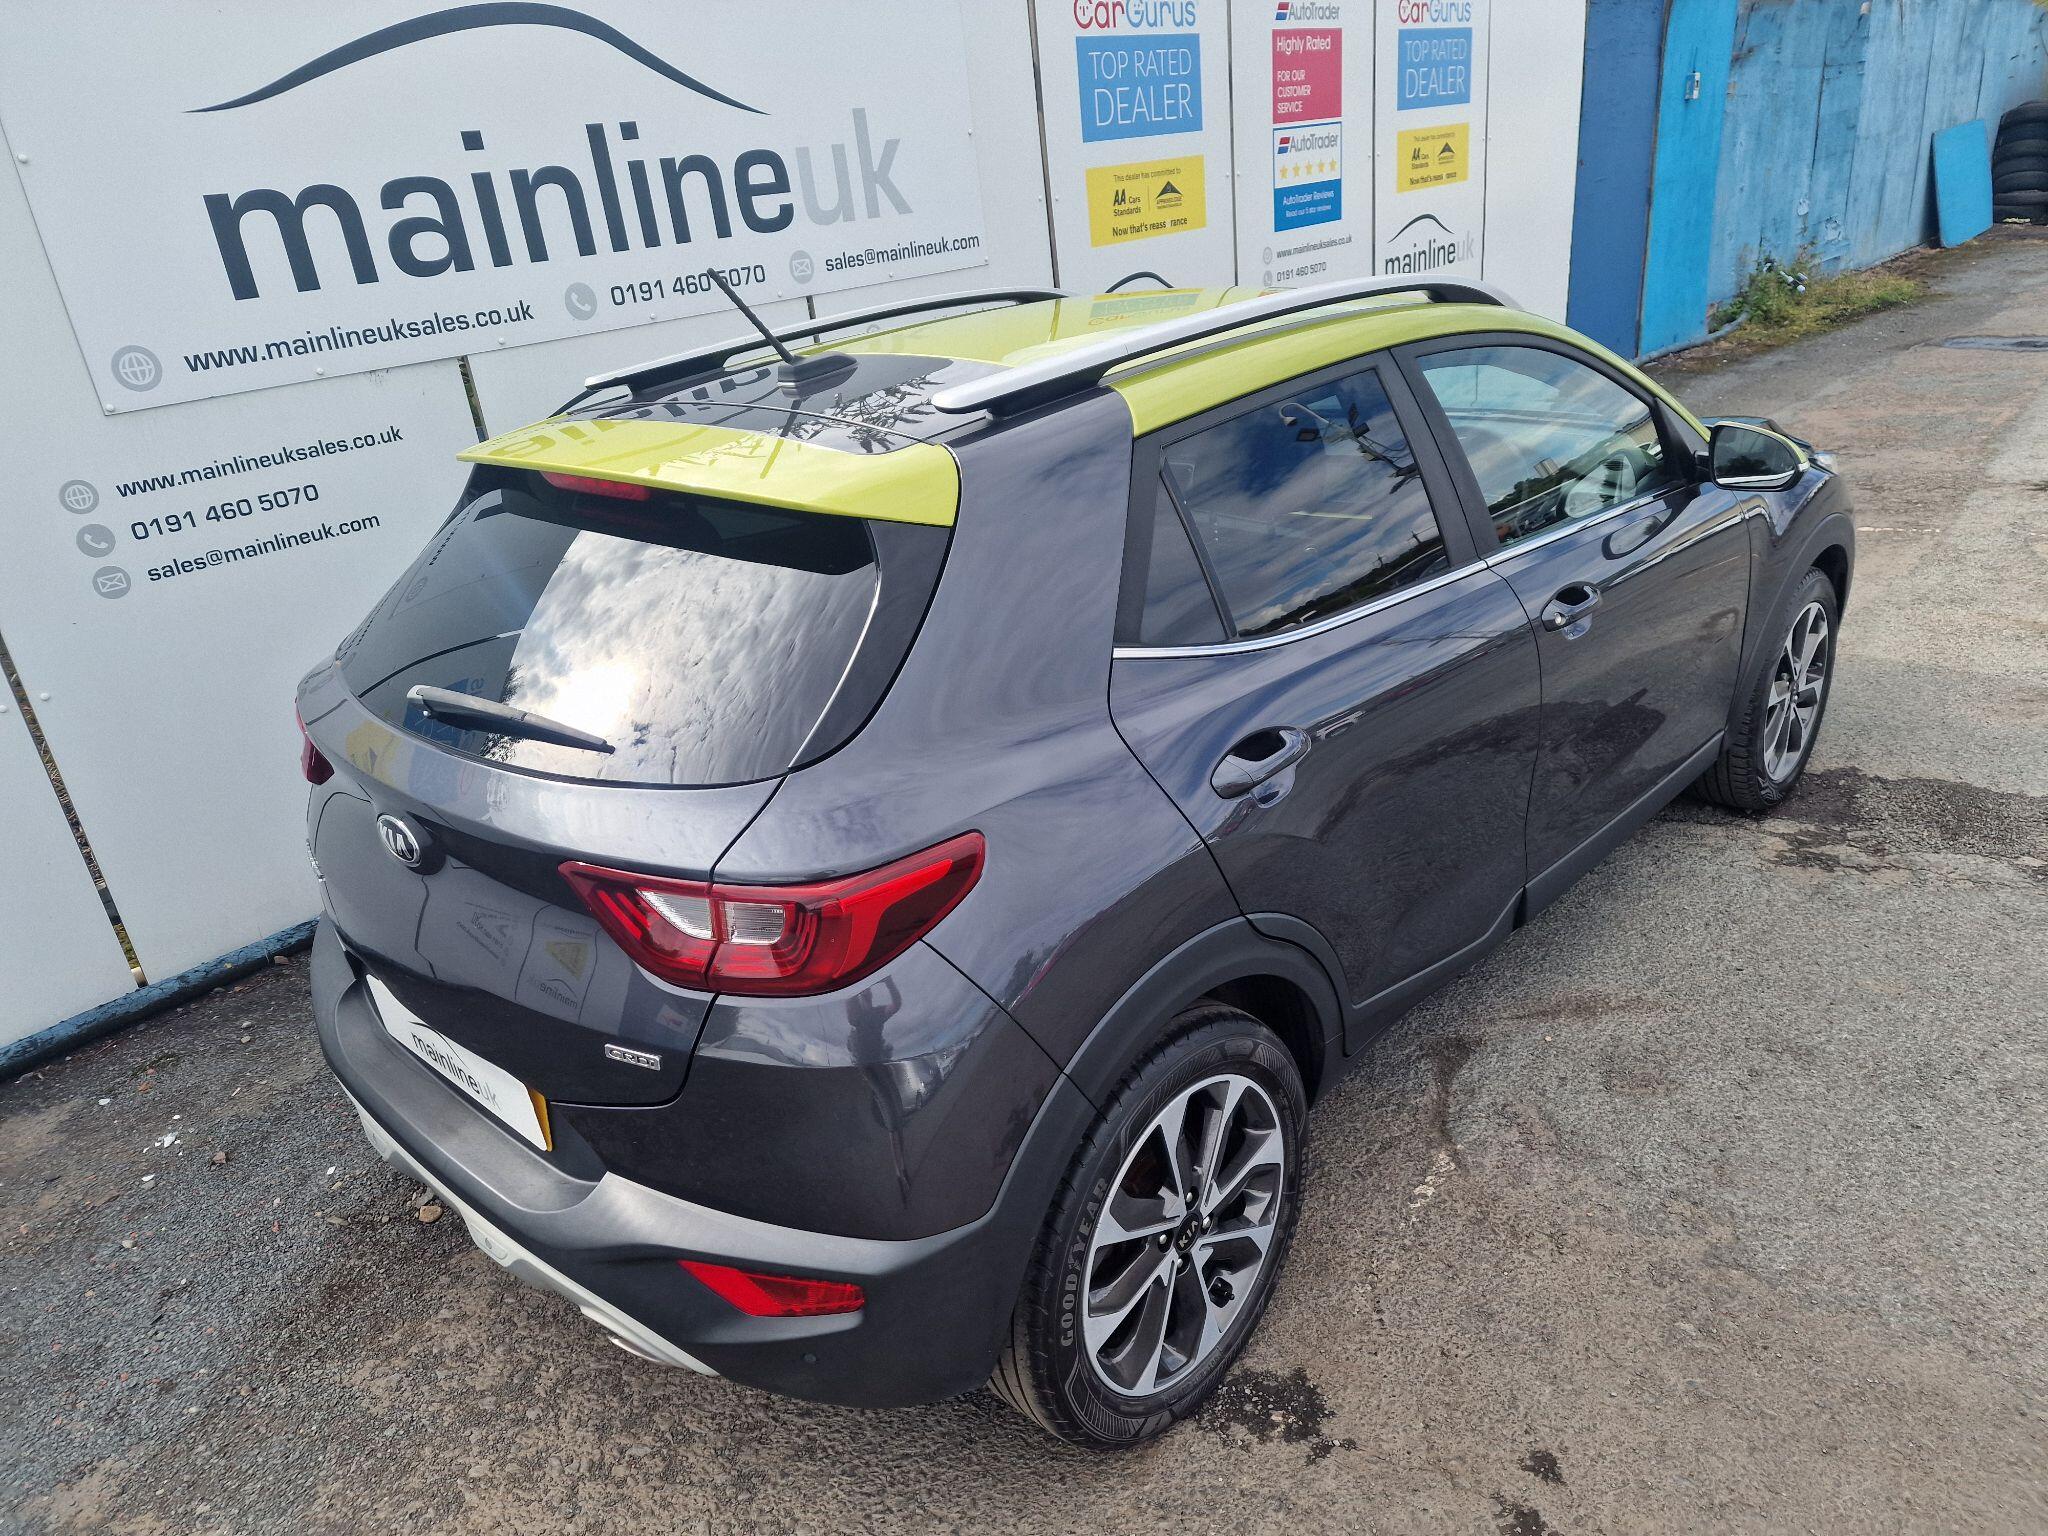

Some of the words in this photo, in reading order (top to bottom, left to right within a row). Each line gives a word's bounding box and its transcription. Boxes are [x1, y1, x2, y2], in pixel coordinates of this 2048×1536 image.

[1073, 0, 1197, 29] CarGurus
[1288, 2, 1340, 20] AutoTrader
[1398, 0, 1472, 23] CarGurus
[1276, 36, 1304, 54] Highly
[1306, 35, 1331, 50] Rated
[1405, 40, 1430, 62] TOP
[1431, 38, 1467, 61] RATED
[1088, 51, 1129, 80] TOP
[1134, 48, 1192, 77] RATED
[1277, 70, 1291, 82] FOR
[1291, 69, 1306, 81] OUR
[1277, 84, 1312, 98] CUSTOMER
[1406, 65, 1466, 98] DEALER
[1094, 83, 1193, 126] DEALER
[1277, 101, 1304, 114] SERVICE
[1290, 133, 1339, 153] AutoTrader
[203, 107, 913, 301] mainlineuk
[1112, 188, 1127, 206] AA
[1128, 195, 1142, 204] Cars
[1112, 206, 1142, 218] Standards
[1112, 226, 1129, 238] Now
[1129, 221, 1149, 234] that's
[1384, 231, 1475, 275] mainlineuk
[1276, 268, 1294, 282] 0191
[183, 299, 535, 373] www.mainlineuksales.co.uk
[610, 279, 666, 307] 0191
[672, 270, 713, 296] 460
[824, 234, 981, 273] sales@mainlineuk.com
[115, 425, 404, 498] www.mainlineuksales.co.uk
[130, 511, 197, 541] 0191
[205, 498, 253, 524] 460
[257, 483, 320, 513] 5070
[146, 515, 381, 582] sales@mainlineuk.com
[410, 1032, 503, 1112] mainlineuk
[1177, 1219, 1200, 1249] KIA
